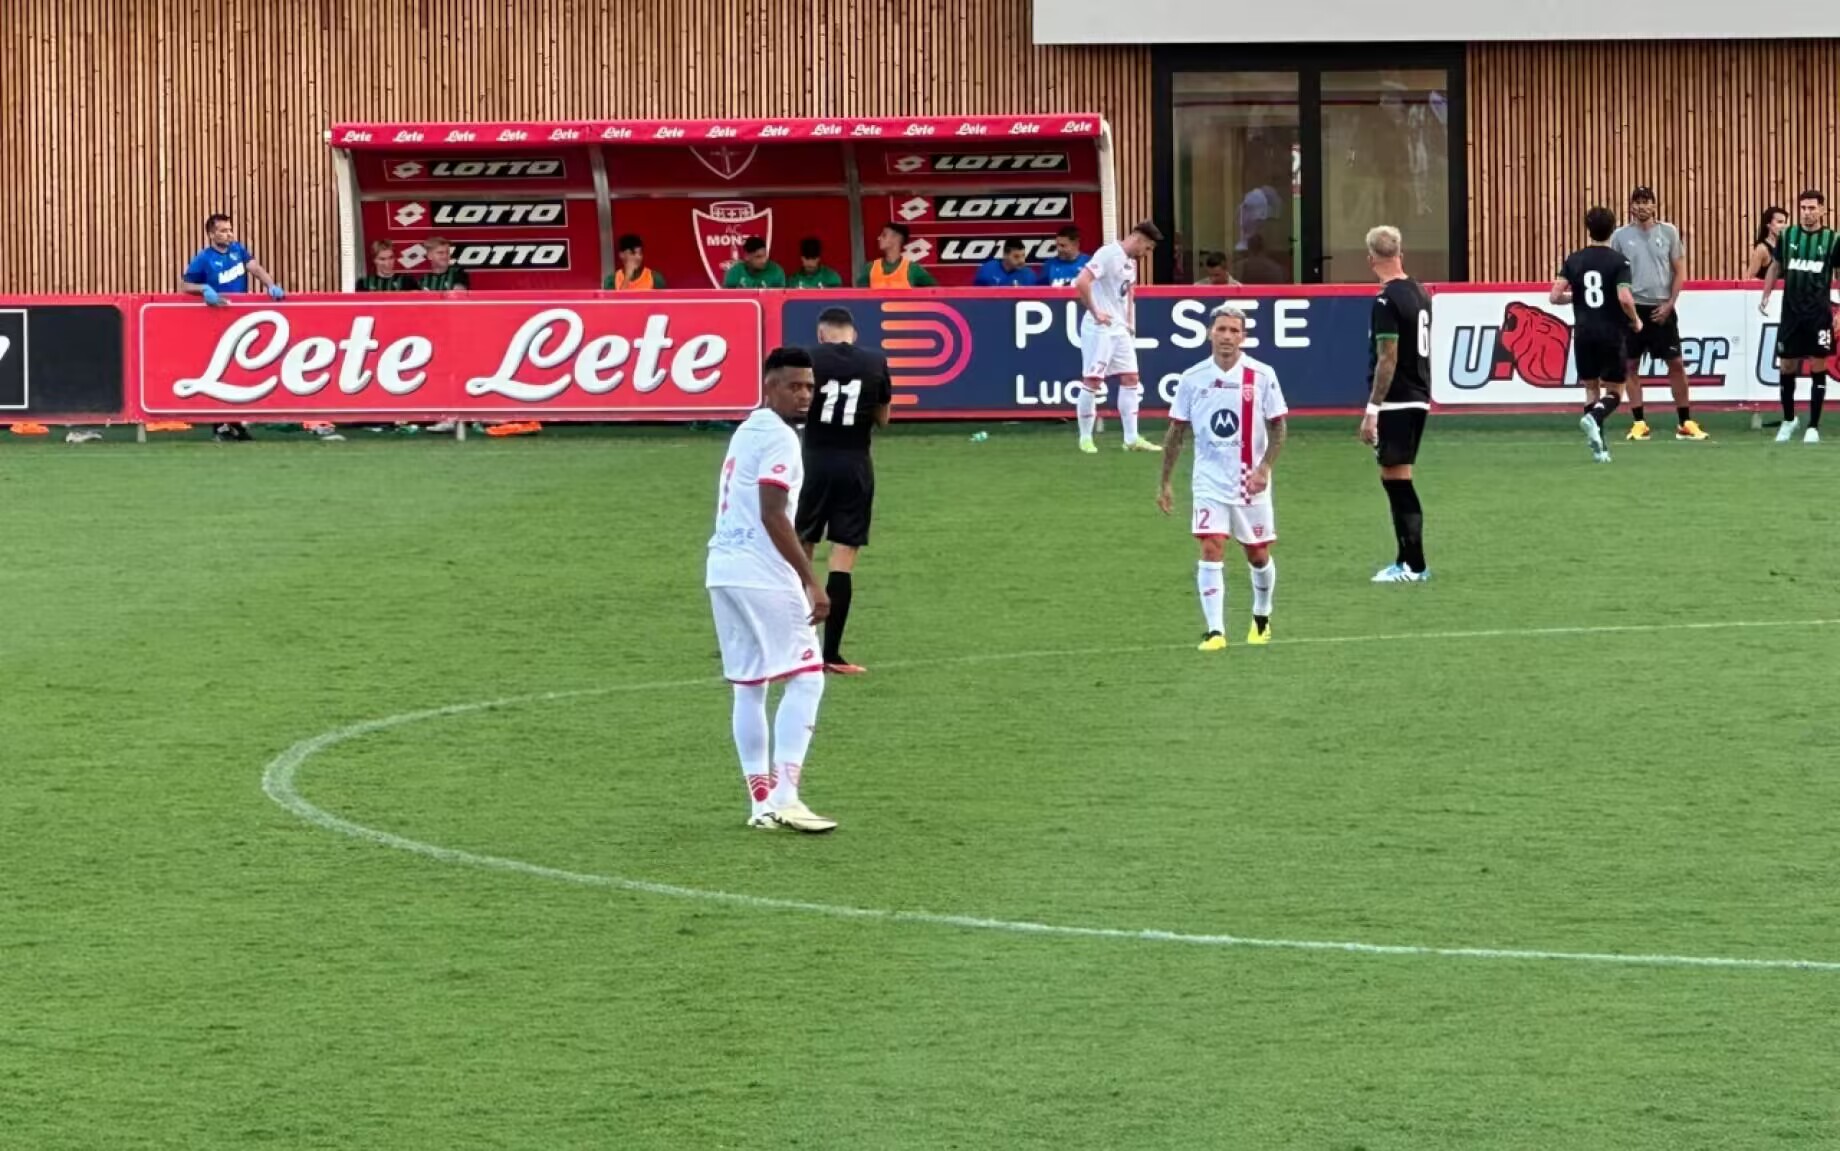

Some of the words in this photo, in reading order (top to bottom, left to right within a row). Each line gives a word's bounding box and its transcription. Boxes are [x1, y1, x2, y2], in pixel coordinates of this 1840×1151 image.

[341, 129, 373, 143] Lete
[393, 130, 424, 143] Lete
[444, 129, 476, 142] Lete
[496, 128, 528, 142] Lete
[547, 128, 579, 142] Lete
[601, 126, 632, 140] Lete
[653, 126, 685, 139] Lete
[705, 125, 736, 138] Lete
[757, 124, 790, 138] Lete
[811, 124, 842, 136] Lete
[851, 124, 882, 136] Lete
[903, 123, 935, 136] Lete
[955, 122, 988, 136] Lete
[1008, 121, 1040, 135] Lete
[1060, 120, 1092, 133] Lete
[432, 161, 560, 176] LOTTO
[934, 154, 1065, 169] LOTTO
[434, 204, 562, 223] LOTTO
[938, 197, 1068, 217] LOTTO
[706, 234, 759, 246] MON
[1583, 270, 1604, 308] 8
[1417, 309, 1430, 357] 6
[172, 309, 433, 402] Lete
[465, 308, 729, 401] Lete
[820, 379, 862, 426] 11
